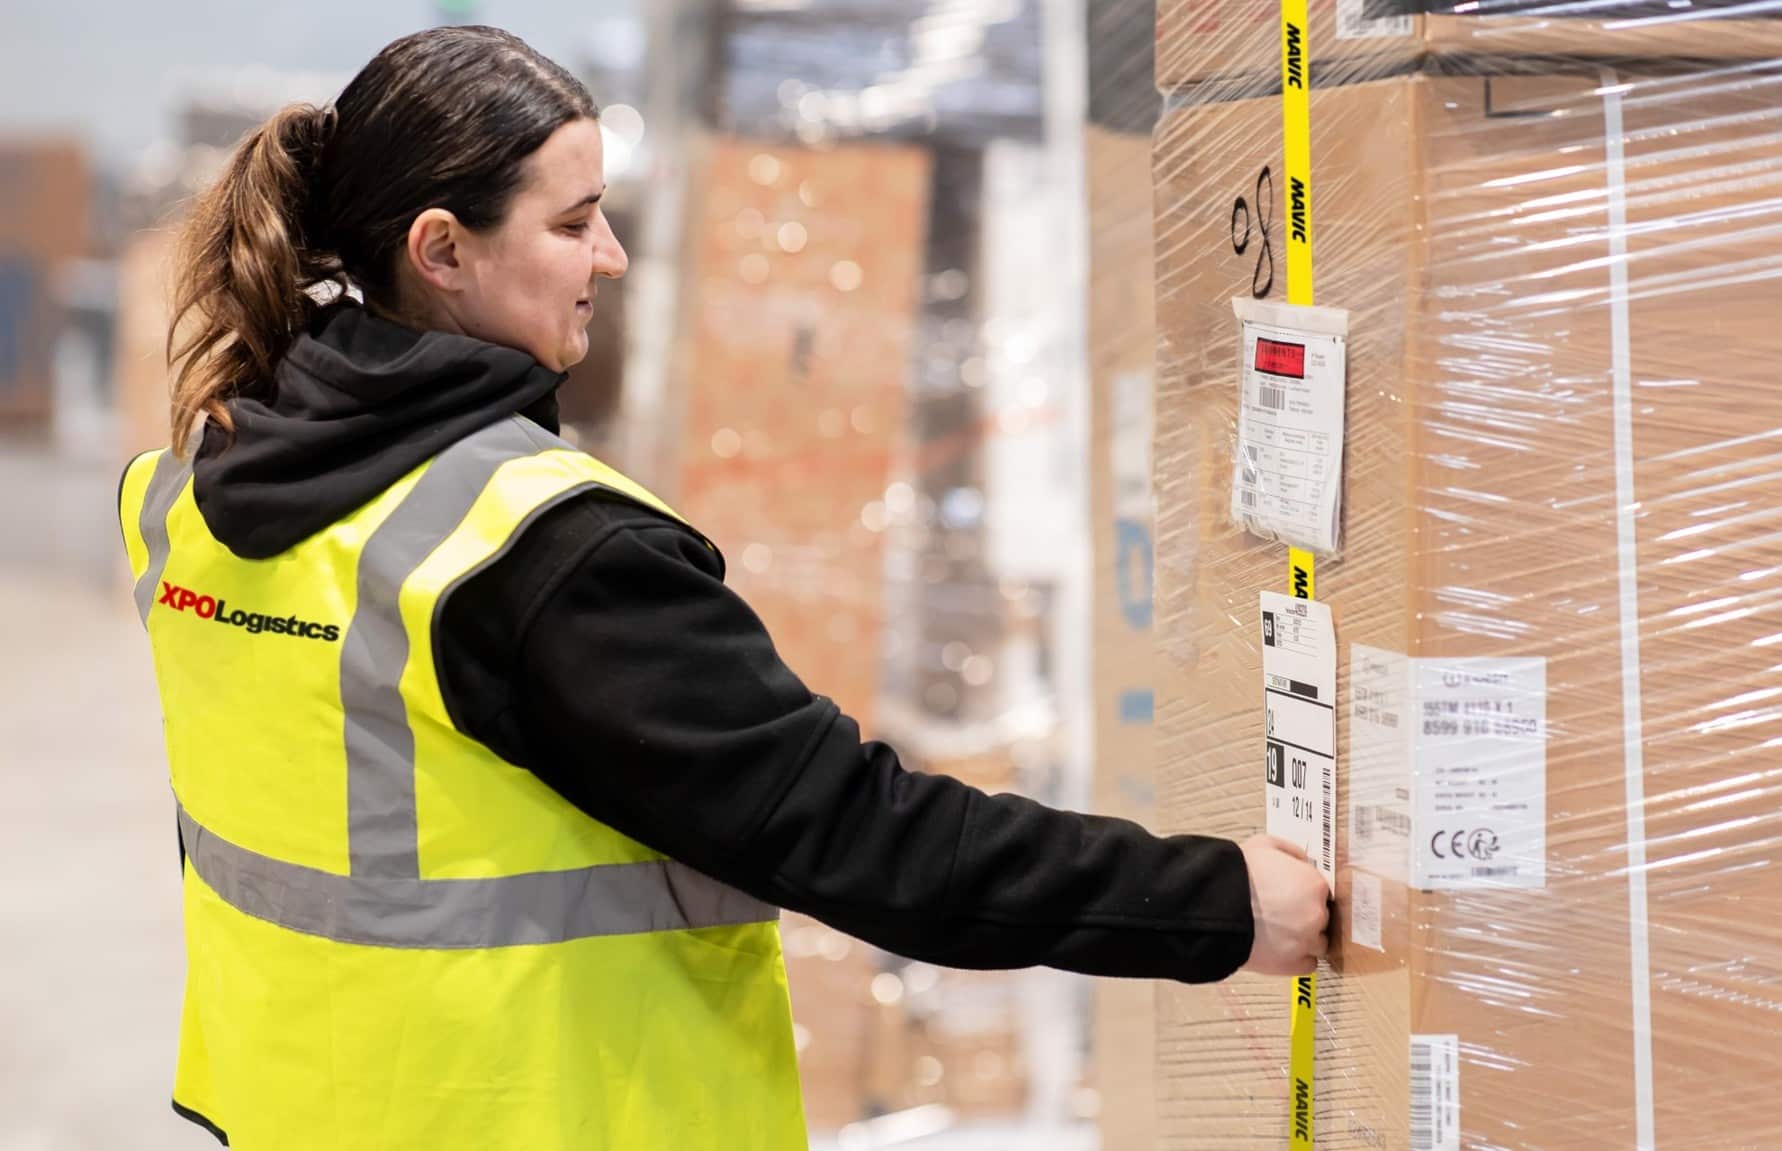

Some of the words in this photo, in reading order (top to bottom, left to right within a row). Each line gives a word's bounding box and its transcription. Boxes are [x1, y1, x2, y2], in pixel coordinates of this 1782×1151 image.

[1286, 22, 1302, 90] MAVIC
[1290, 176, 1306, 243] MAVIC
[1267, 746, 1278, 783] 19
[1291, 757, 1307, 790] Q07
[1298, 976, 1311, 1009] VIC
[1294, 1077, 1309, 1143] MAVIC
